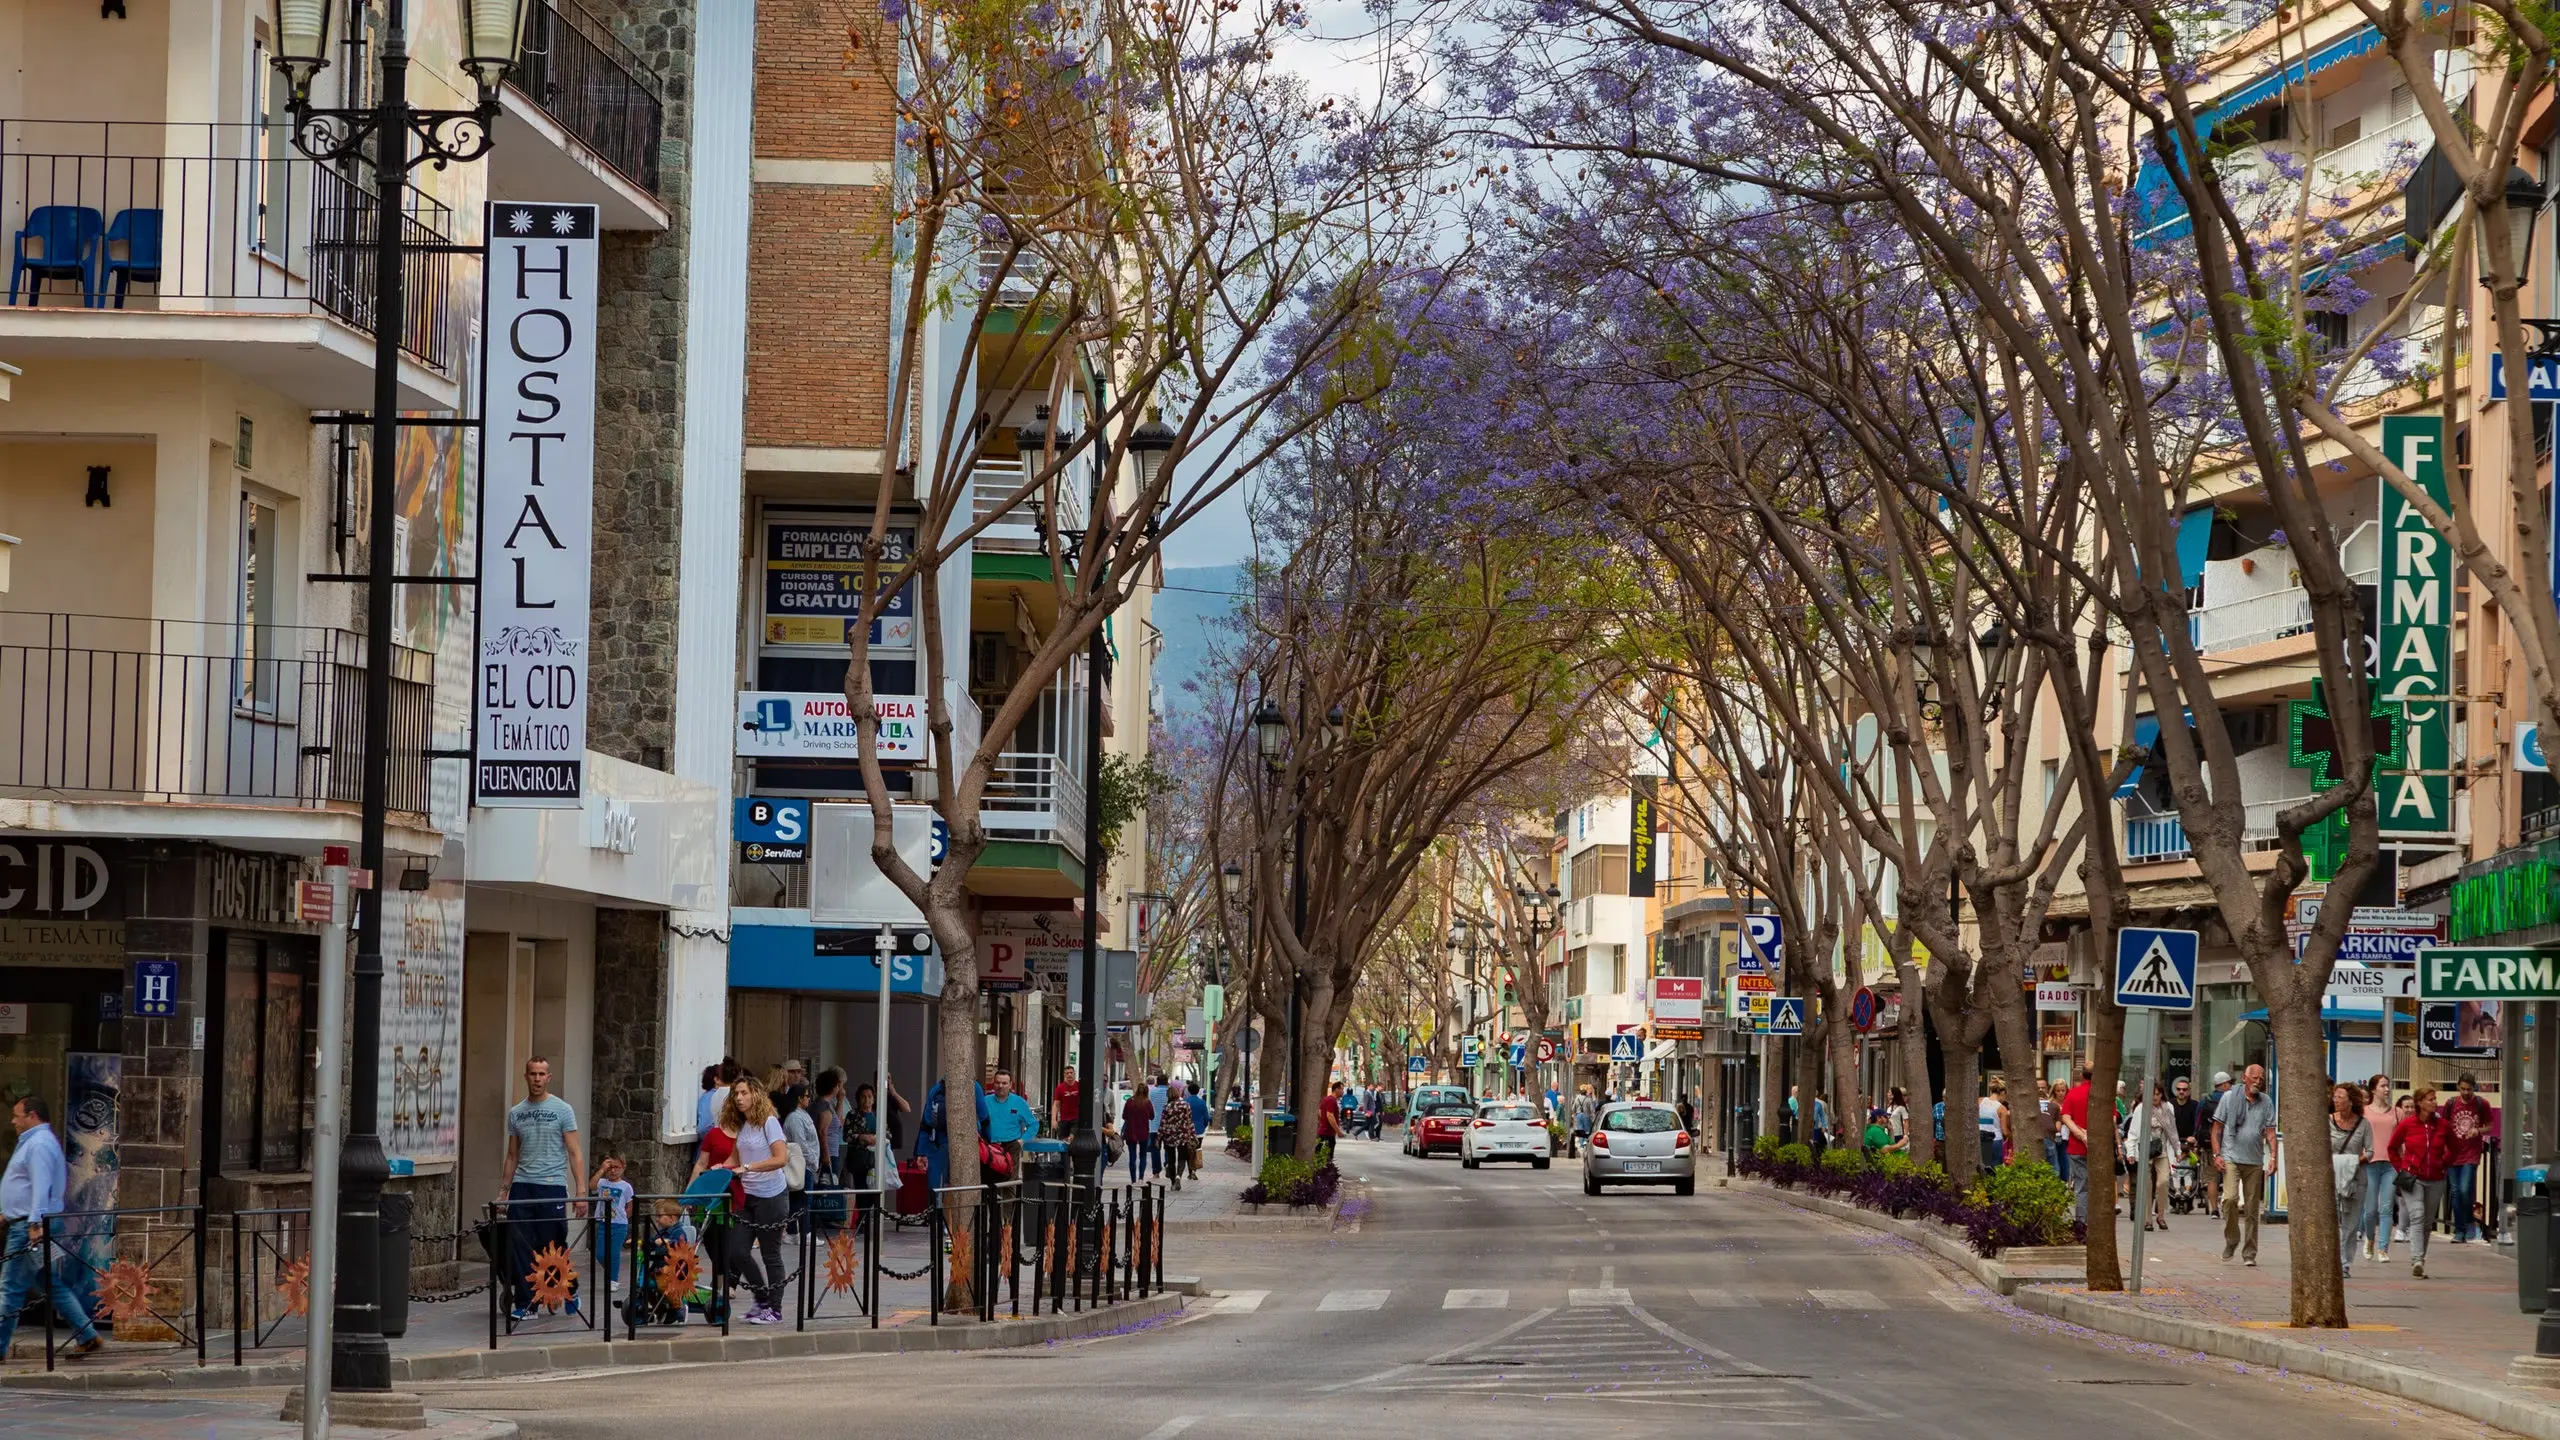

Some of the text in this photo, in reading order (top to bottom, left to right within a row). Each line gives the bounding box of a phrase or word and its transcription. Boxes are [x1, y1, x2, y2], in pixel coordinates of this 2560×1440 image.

[503, 245, 572, 610] HOSTAL
[782, 531, 862, 543] FORMACIÓN
[781, 544, 902, 559] EMPLEAOS
[781, 573, 820, 581] CURSOS
[781, 581, 835, 591] IDIOMAS
[780, 594, 902, 610] GRATUIS
[2390, 435, 2440, 819] FARMACIA
[486, 664, 576, 710] EL CID
[804, 702, 915, 718] AUTOEUELA
[804, 722, 914, 739] MARBULA
[803, 740, 859, 750] Driving Schoo
[481, 766, 576, 792] FUENGIROLA
[775, 807, 801, 840] S
[765, 849, 802, 858] ServiRed
[213, 850, 280, 922] HOSTAL
[1024, 934, 1048, 948] nish
[1741, 917, 1775, 958] P
[990, 944, 1013, 973] P
[1741, 961, 1757, 969] LAS
[1740, 977, 1776, 988] INTER
[2328, 972, 2384, 985] UNNES
[2430, 958, 2560, 991] FARM
[142, 975, 171, 1001] H
[1673, 982, 1684, 991] M
[1752, 998, 1769, 1007] GLA
